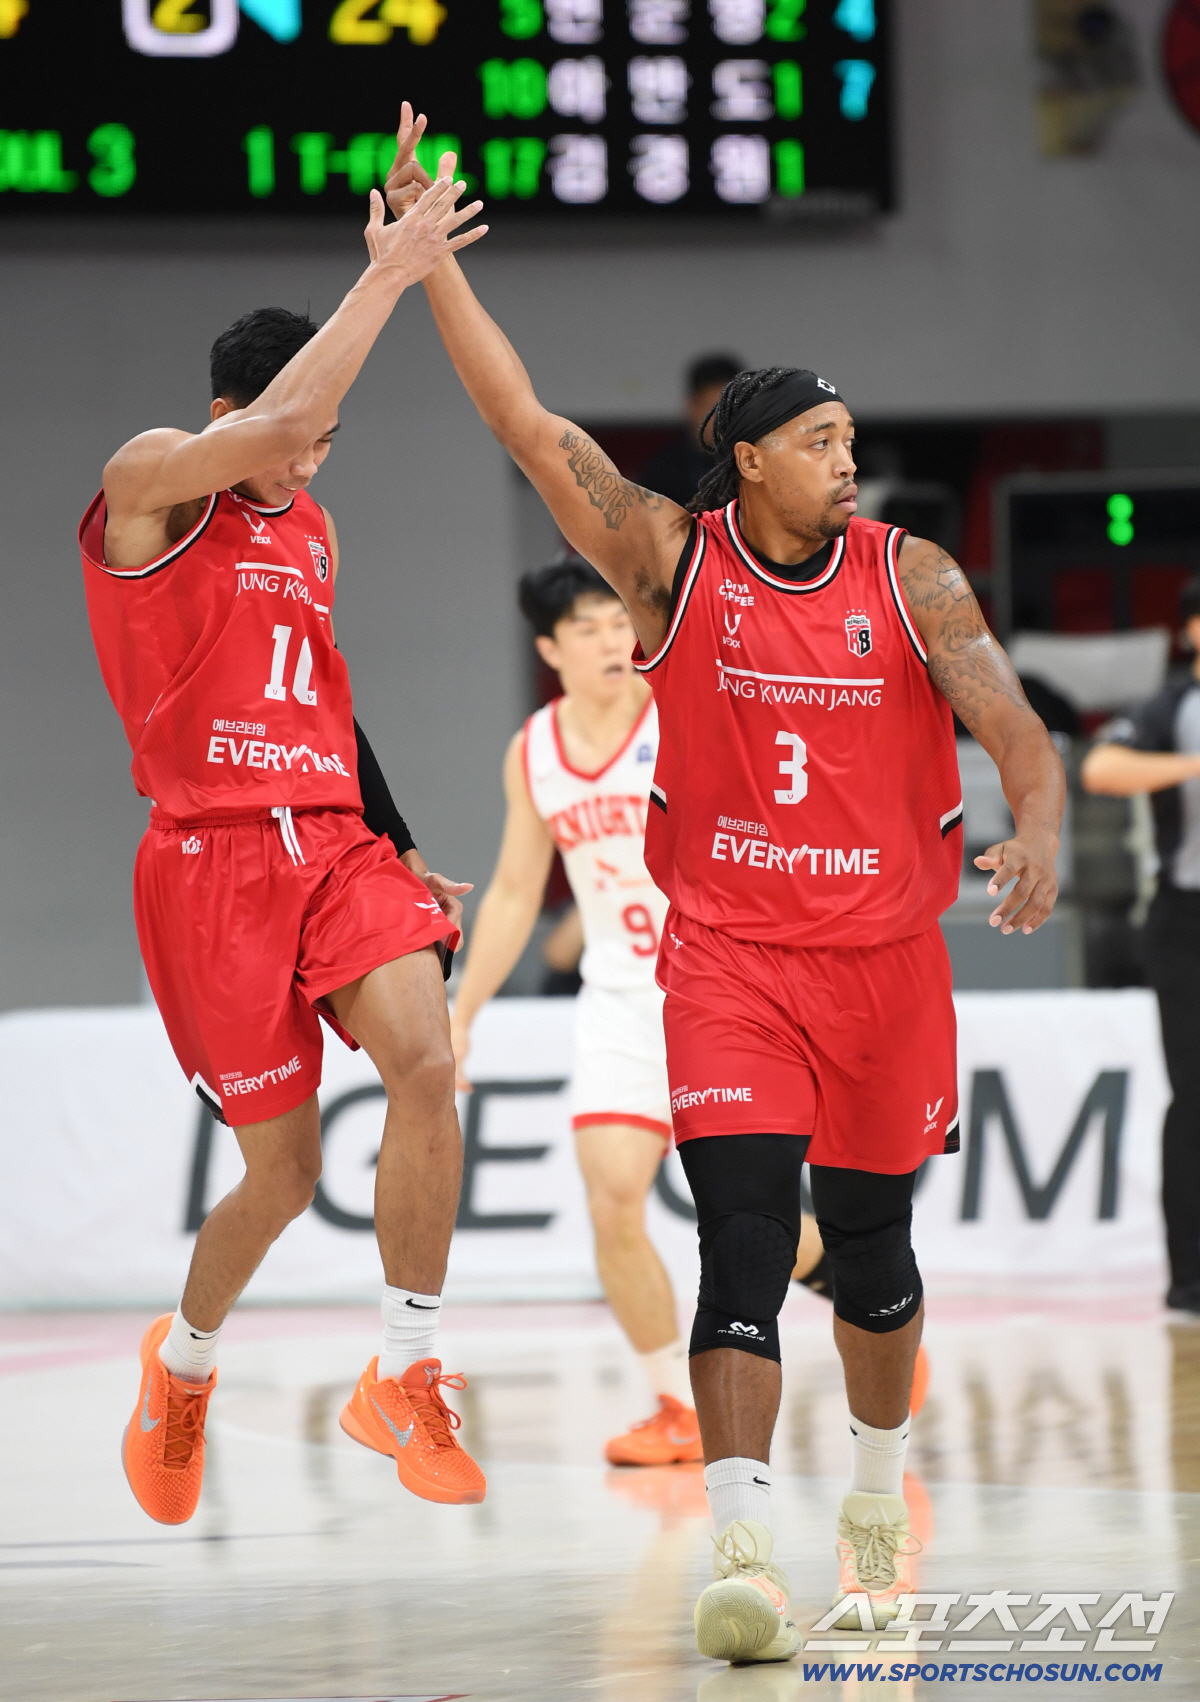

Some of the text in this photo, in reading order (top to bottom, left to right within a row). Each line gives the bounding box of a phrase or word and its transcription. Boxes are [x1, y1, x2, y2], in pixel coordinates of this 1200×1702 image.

[478, 57, 547, 120] 10
[771, 59, 803, 120] 1
[86, 122, 136, 197] 3
[243, 123, 276, 198] 1
[480, 136, 547, 199] 17
[772, 138, 805, 199] 1
[235, 572, 280, 597] JUNG
[723, 578, 749, 594] DIYA
[759, 683, 825, 705] KWAN
[827, 689, 882, 711] JANG
[212, 718, 266, 737] 에브리타임
[774, 730, 808, 805] 3
[547, 792, 650, 852] KNIGHT
[717, 814, 769, 837] 에브리타임
[621, 903, 659, 956] 9
